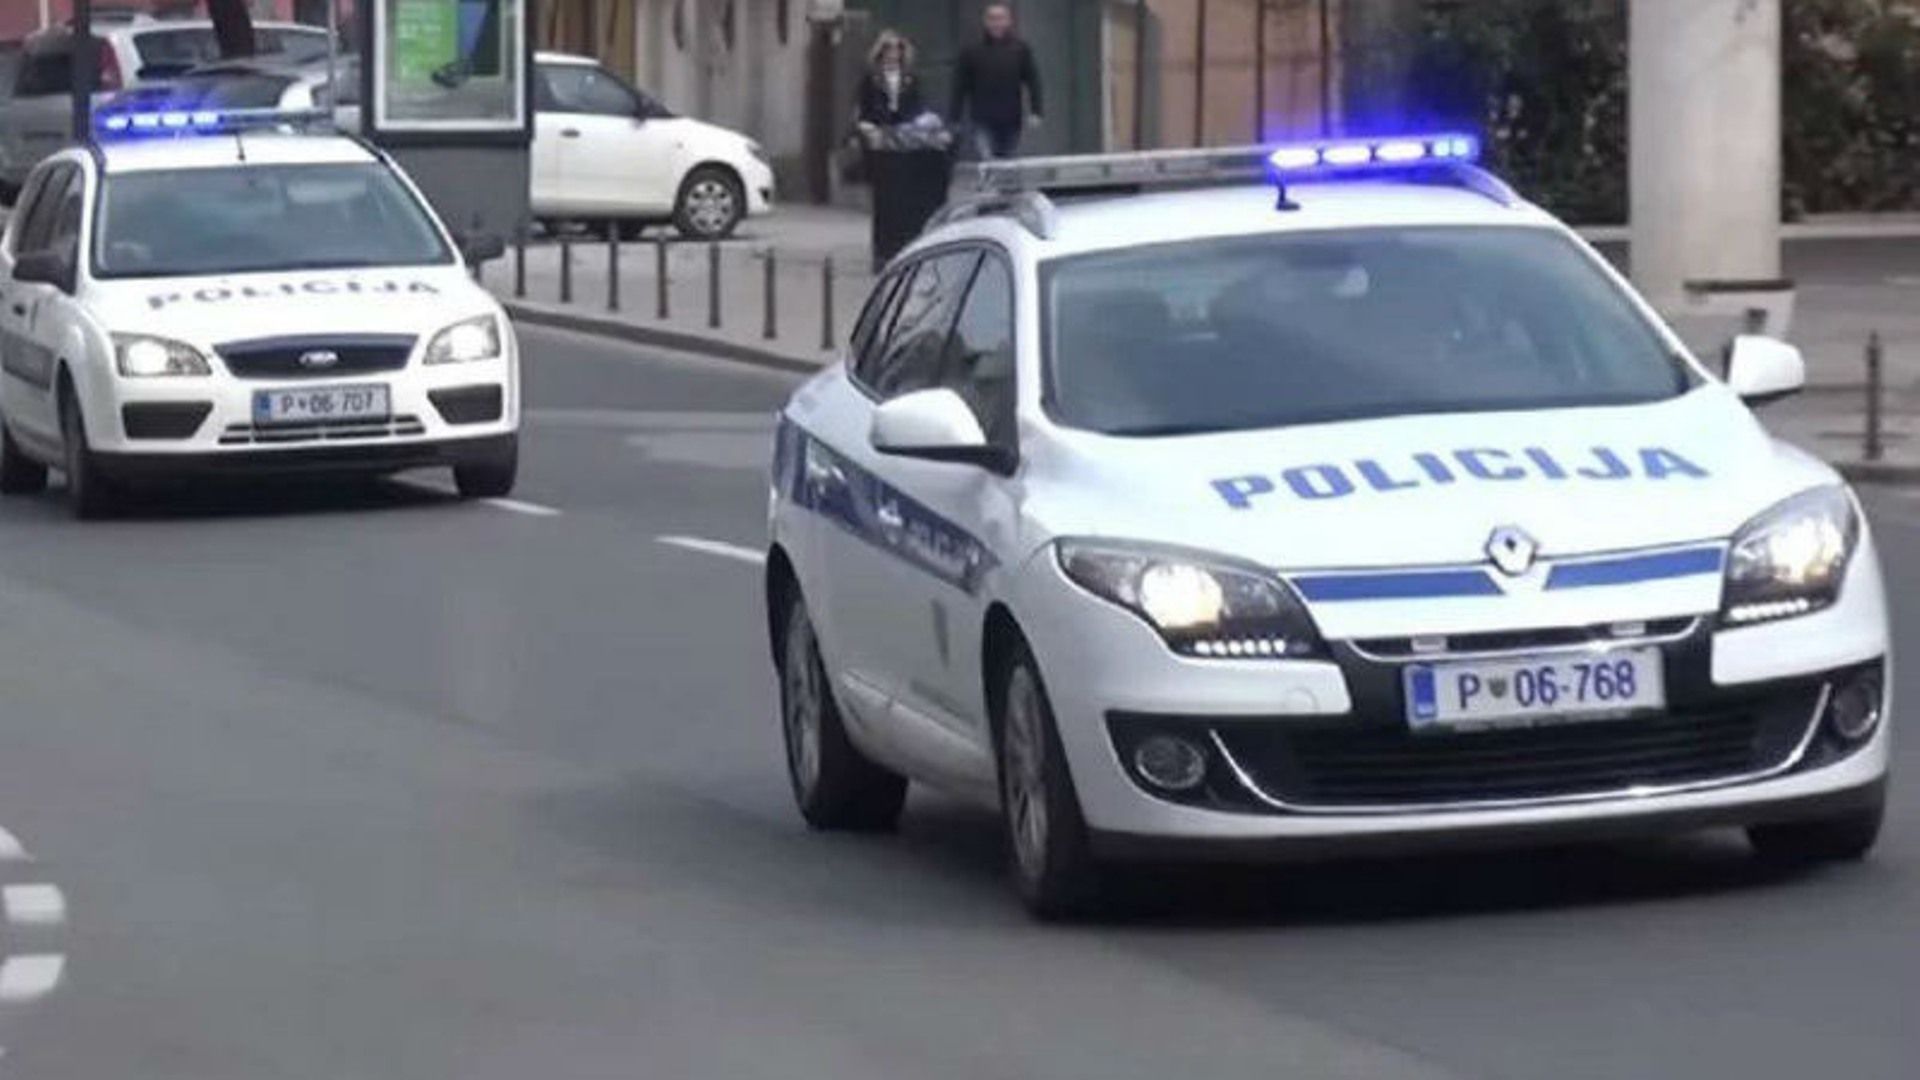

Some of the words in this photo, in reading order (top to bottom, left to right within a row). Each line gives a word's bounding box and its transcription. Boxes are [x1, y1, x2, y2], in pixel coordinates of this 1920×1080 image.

[147, 279, 441, 310] POLICIJA
[1209, 447, 1710, 509] POLICIJA
[1458, 672, 1480, 709] P
[1514, 659, 1636, 707] 06-768
